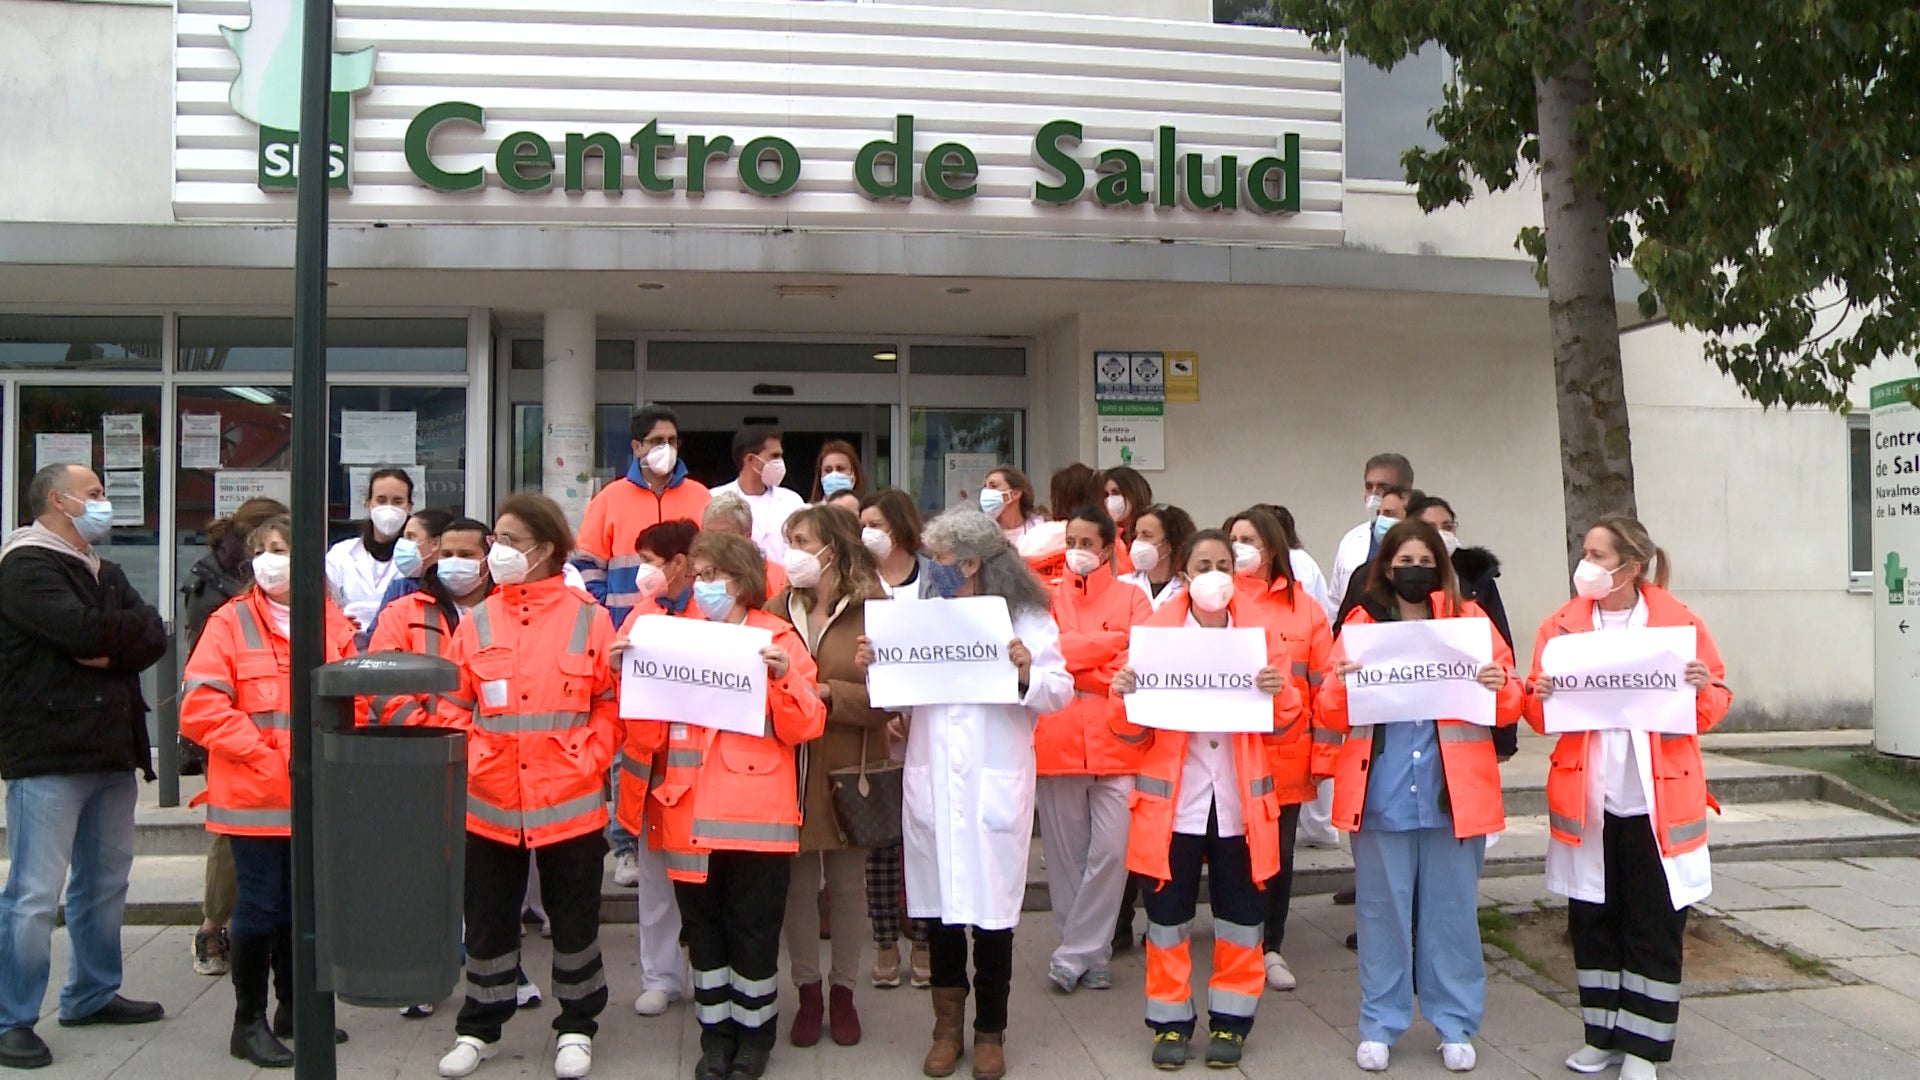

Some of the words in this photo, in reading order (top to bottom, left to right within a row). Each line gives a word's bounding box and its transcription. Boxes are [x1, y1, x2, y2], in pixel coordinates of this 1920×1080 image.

[264, 143, 345, 178] SS
[404, 101, 801, 197] Centro
[853, 114, 978, 202] de
[1032, 119, 1300, 214] Salud
[1102, 425, 1130, 433] Centro
[1876, 459, 1888, 477] de
[1877, 505, 1885, 518] de
[1888, 504, 1896, 516] la
[877, 647, 904, 662] NO
[909, 641, 999, 662] AGRESIÓN
[632, 659, 658, 678] NO
[664, 664, 752, 691] VIOLENCIA
[1135, 673, 1159, 687] NO
[1165, 673, 1253, 688] INSULTOS
[1356, 669, 1383, 685] NO
[1388, 660, 1478, 682] AGRESIÓN
[1553, 675, 1578, 688] NO
[1584, 670, 1677, 688] AGRESIÓN
